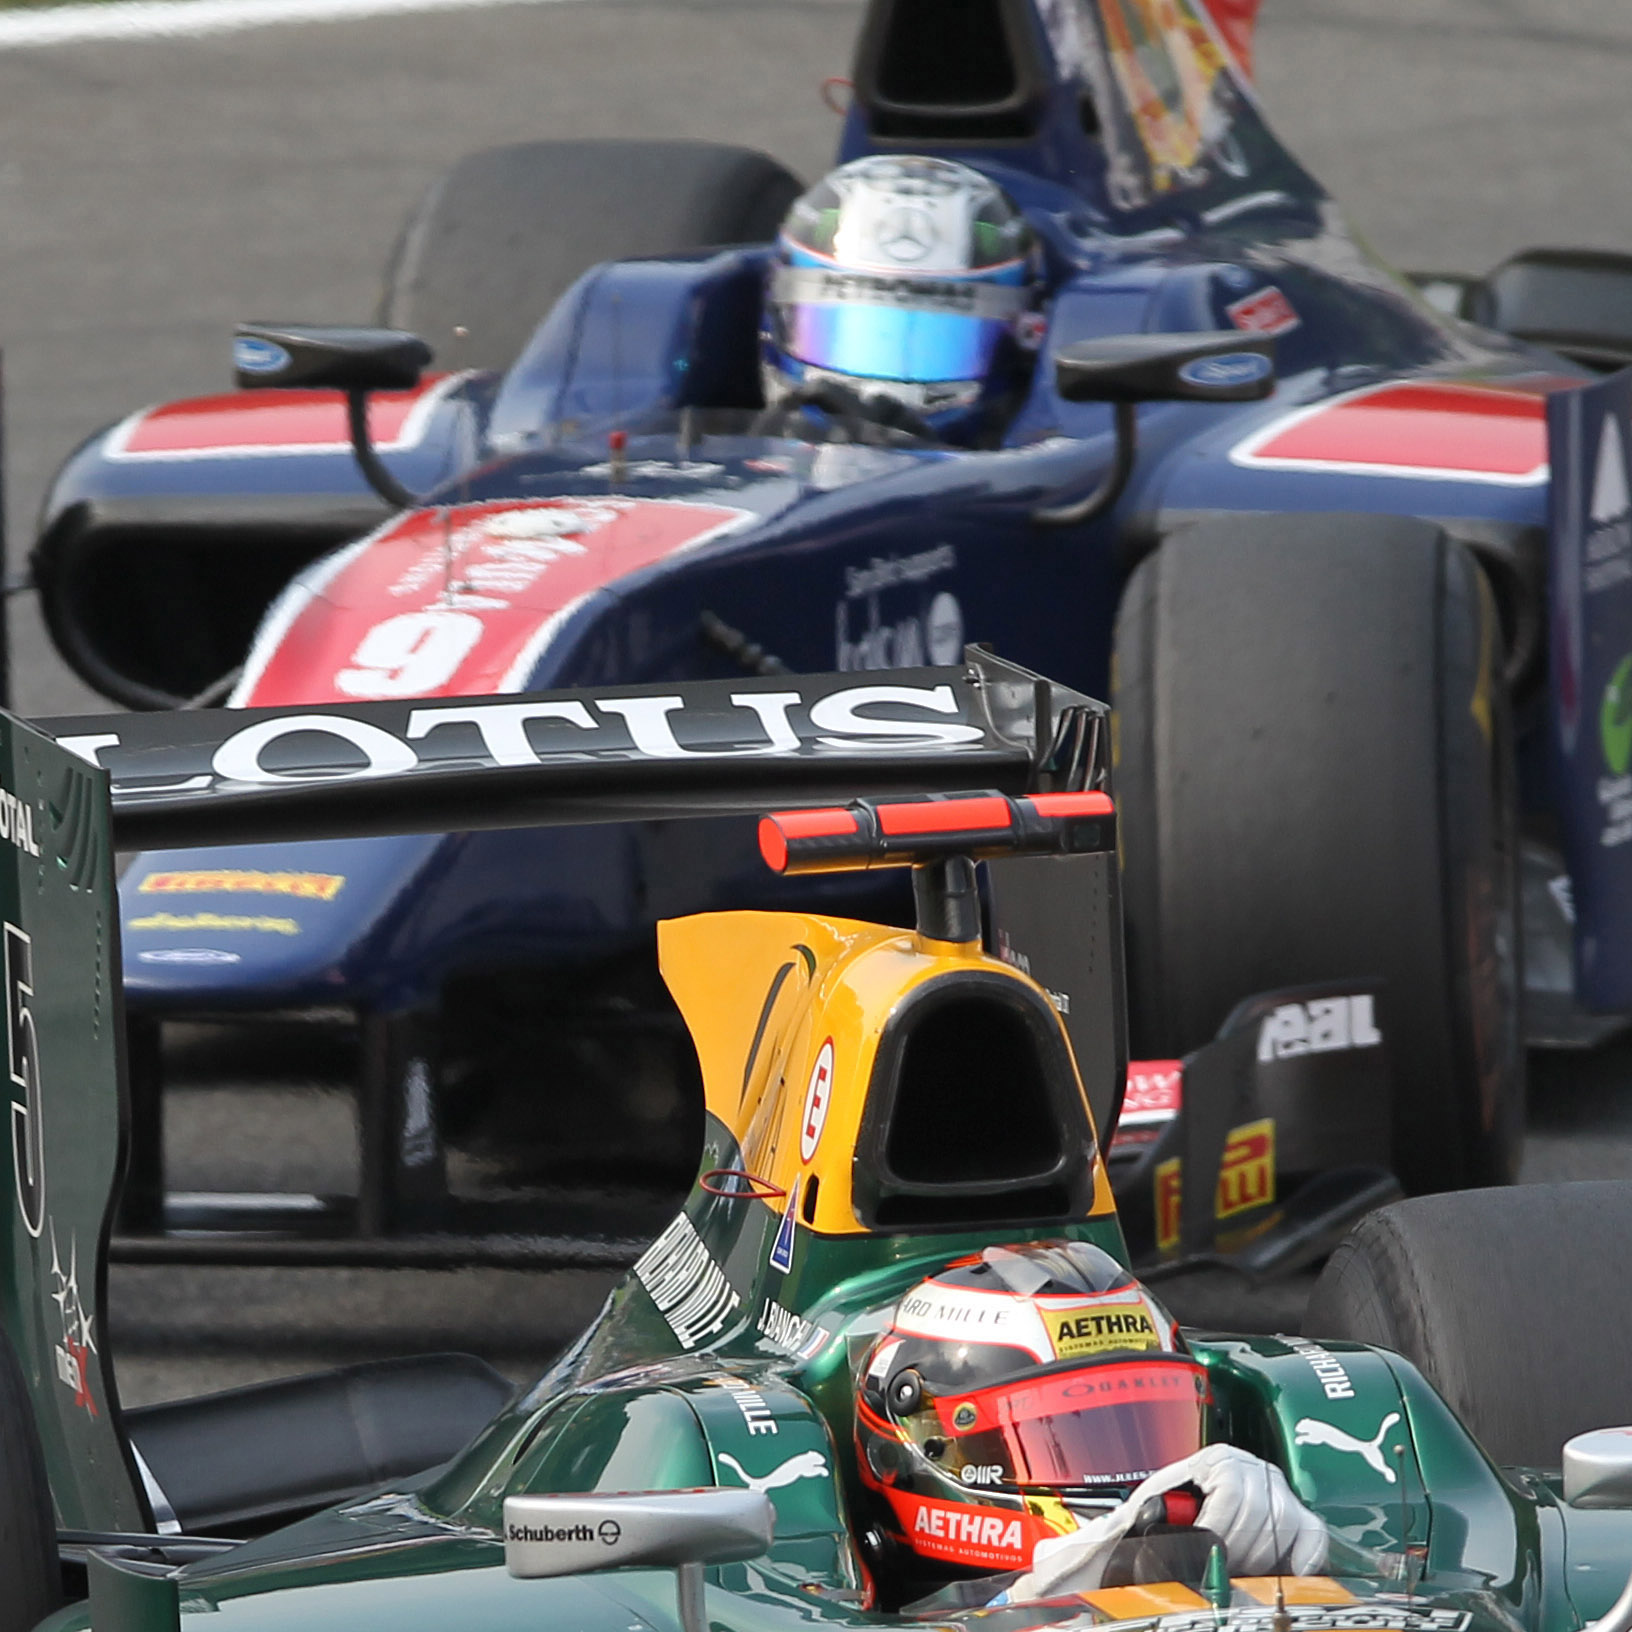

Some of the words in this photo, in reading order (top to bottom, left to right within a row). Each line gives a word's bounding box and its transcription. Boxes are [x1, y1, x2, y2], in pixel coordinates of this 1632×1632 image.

[335, 610, 485, 697] 9
[58, 683, 986, 793] LOTUS
[3, 921, 45, 1237] 5
[633, 1211, 710, 1311] RICHARD
[664, 1260, 742, 1349] MILLE
[1058, 1314, 1154, 1342] AETHRA
[1099, 1375, 1183, 1391] OAKLEY
[508, 1524, 594, 1542] Schuberth
[914, 1505, 1022, 1549] AETHRA
